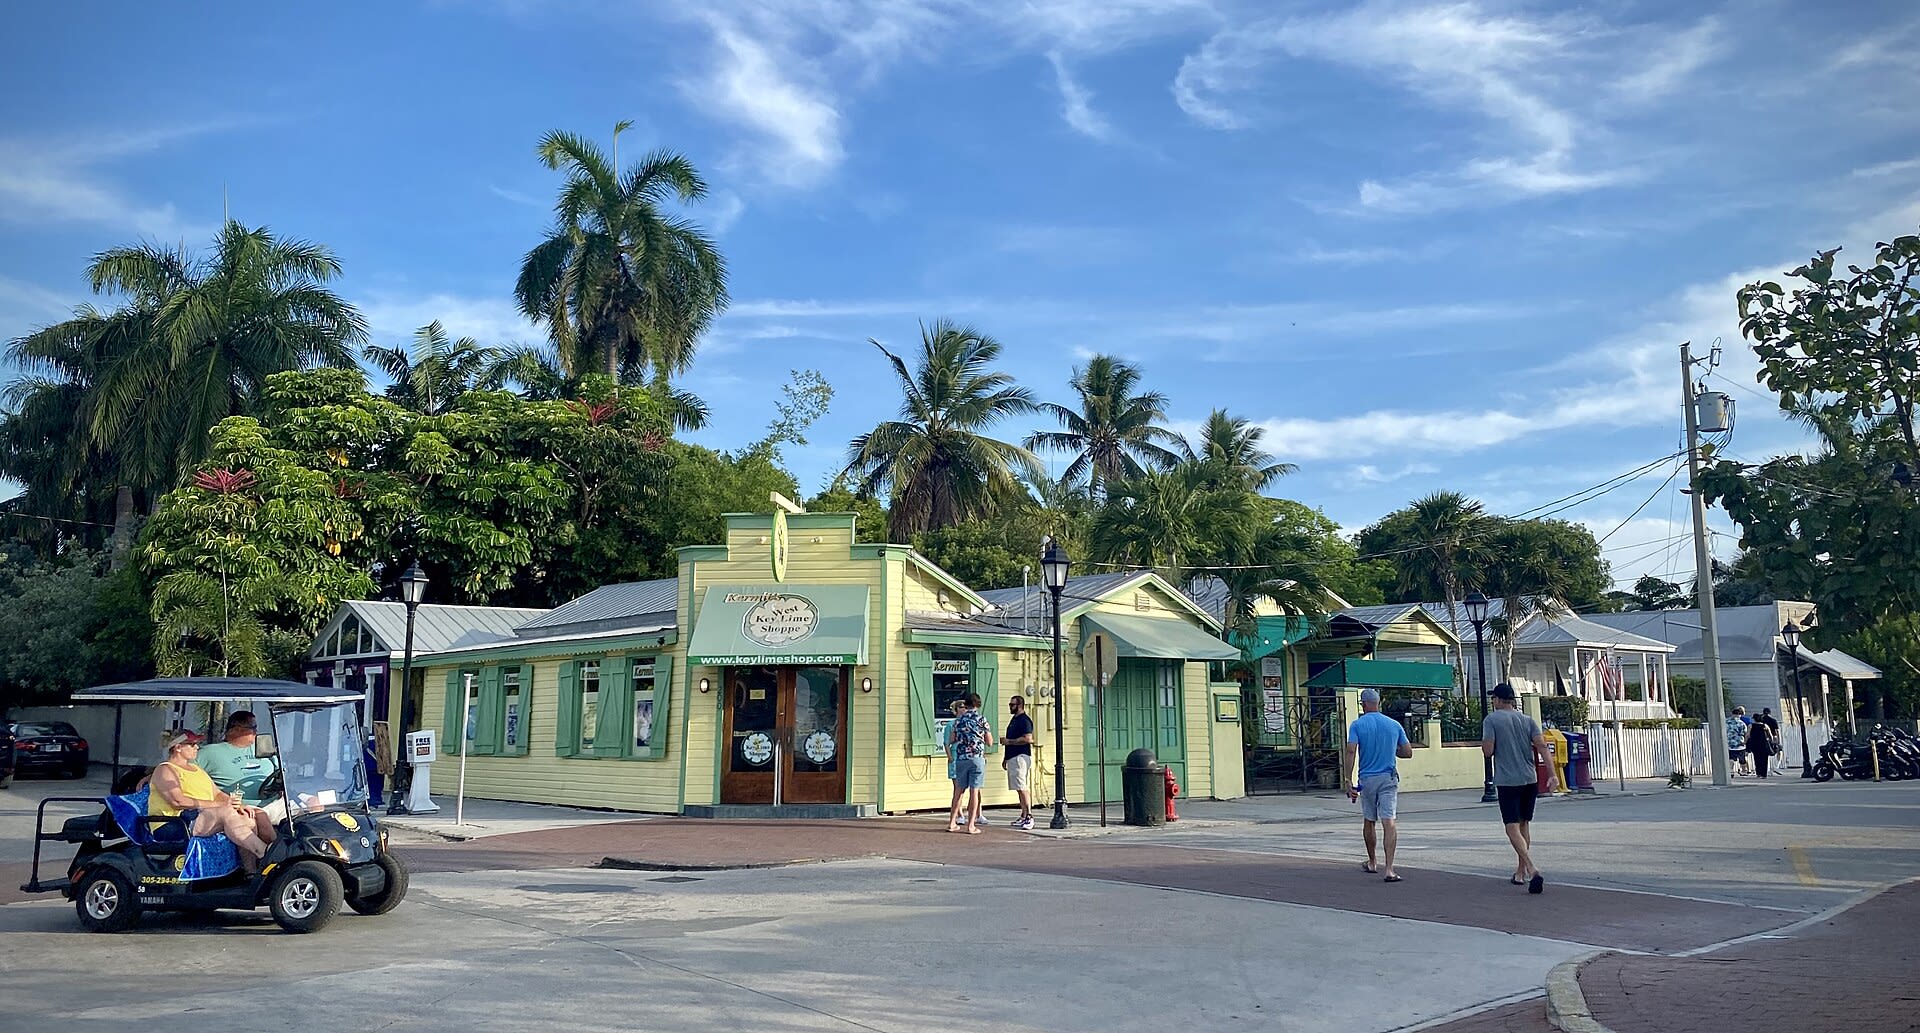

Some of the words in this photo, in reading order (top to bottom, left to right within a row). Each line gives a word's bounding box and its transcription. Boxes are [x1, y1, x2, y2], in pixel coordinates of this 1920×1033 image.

[772, 605, 799, 617] West
[755, 615, 777, 624] Key
[780, 615, 810, 623] Lime
[760, 625, 801, 634] Shoppe
[700, 654, 844, 665] www.keylimeshop.com
[934, 661, 969, 672] Kermit's
